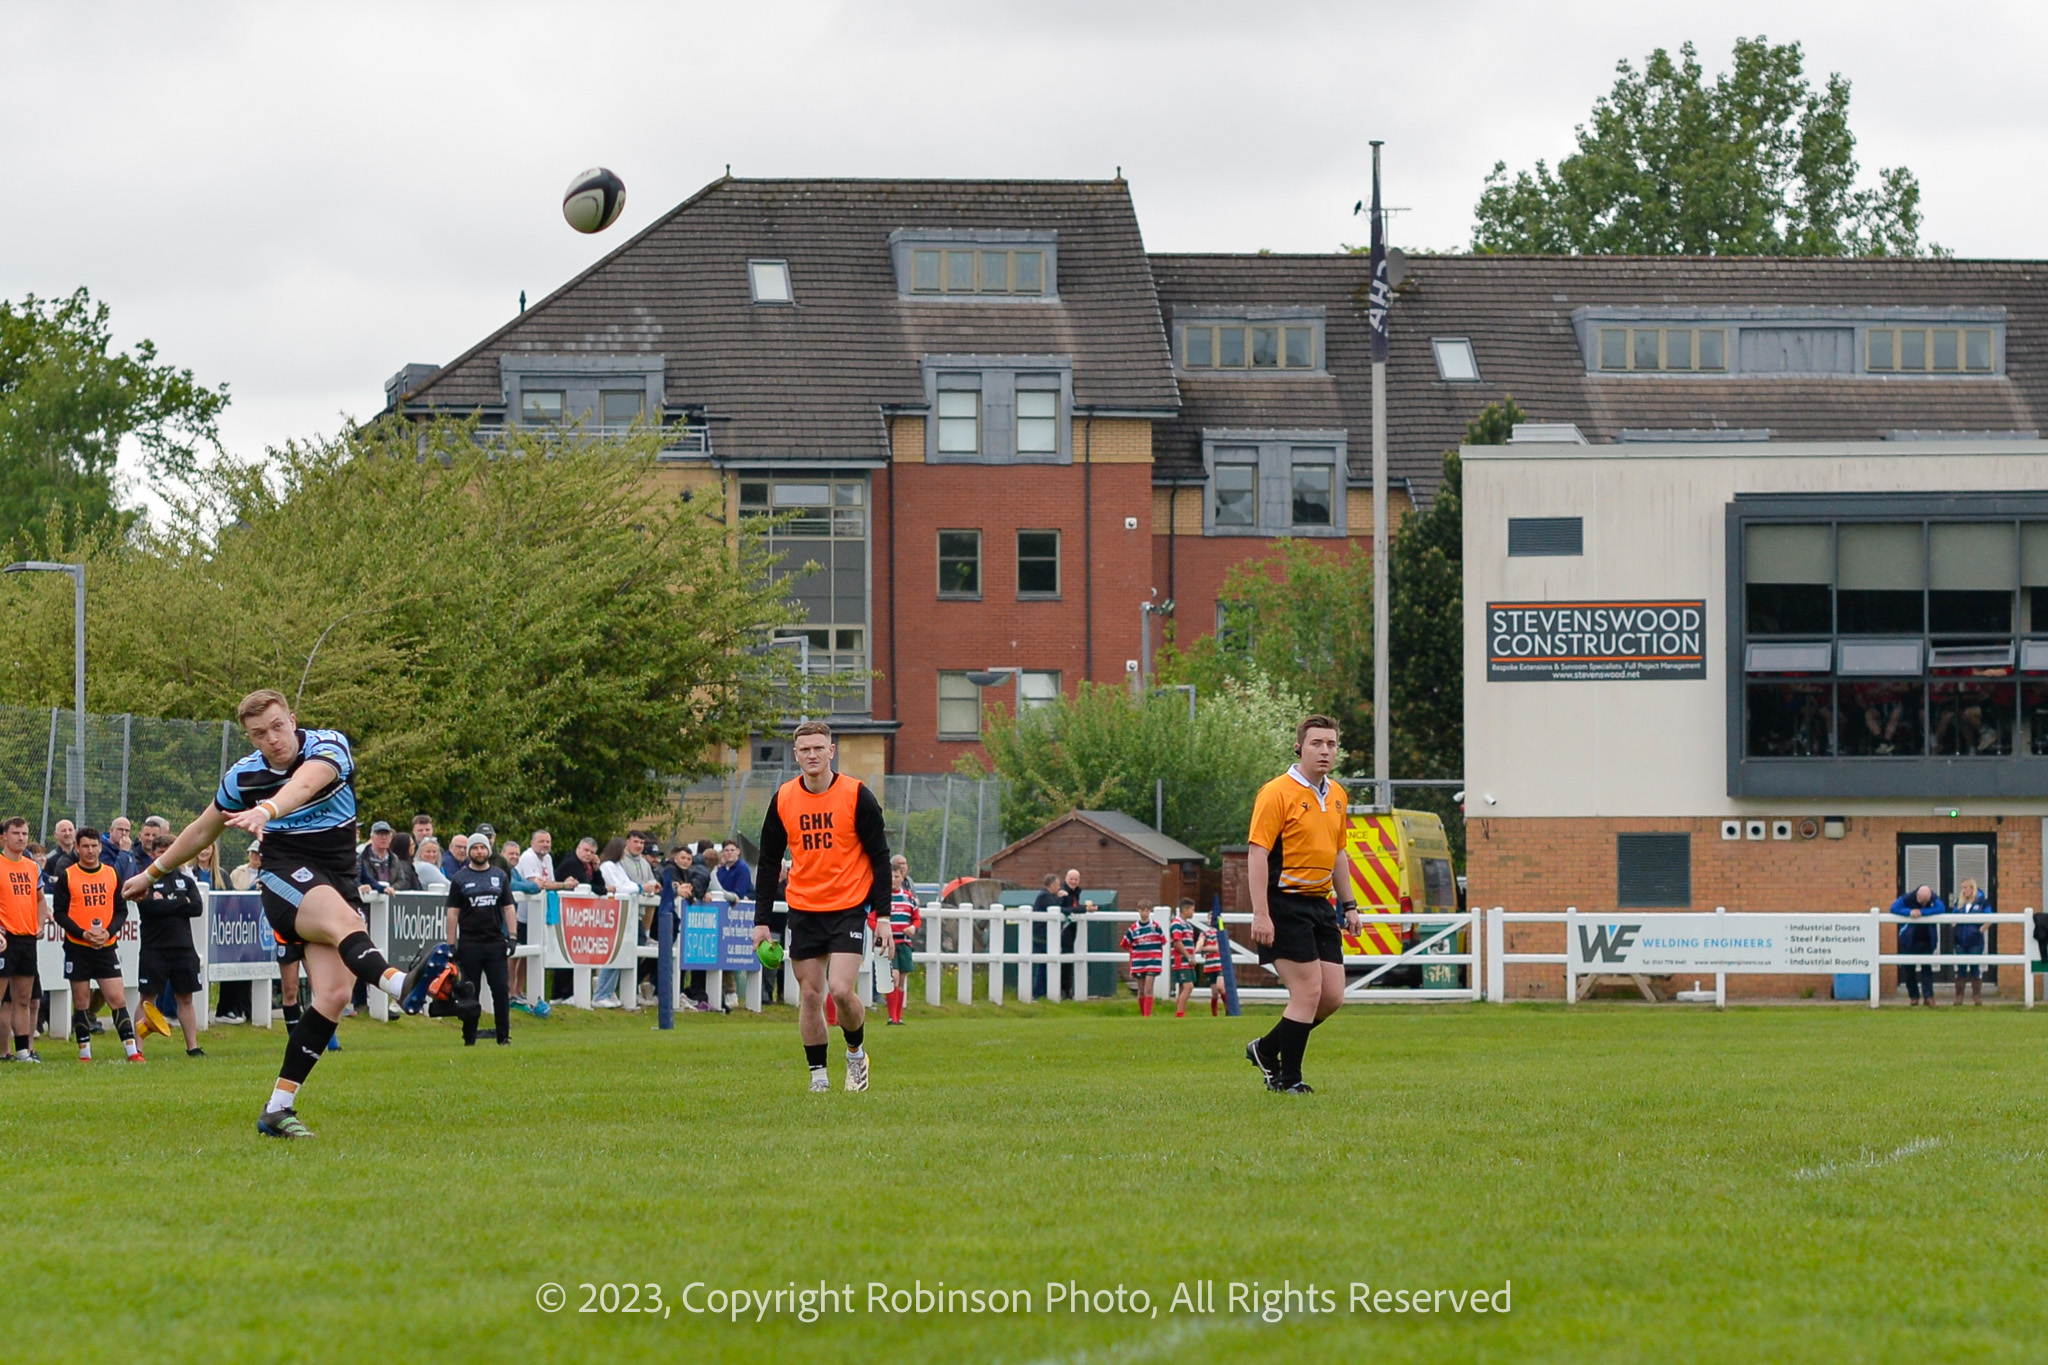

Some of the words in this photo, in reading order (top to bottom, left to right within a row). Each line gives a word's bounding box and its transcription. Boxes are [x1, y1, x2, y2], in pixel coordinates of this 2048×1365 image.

[1493, 608, 1700, 633] STEVENSWOOD
[1492, 632, 1700, 656] CONSTRUCTION
[1491, 663, 1518, 673] Bespoke
[1519, 662, 1553, 671] Extensions
[1553, 663, 1560, 671] &
[1560, 662, 1588, 671] Sunroom
[1624, 661, 1637, 670] Full
[1637, 661, 1660, 671] Project
[1660, 661, 1701, 671] Management
[1551, 669, 1641, 680] www.stevenswood.net
[799, 812, 834, 831] GHK
[802, 832, 833, 851] RFC
[9, 872, 32, 884] GHK
[13, 884, 32, 896] RFC
[82, 883, 107, 895] GHK
[83, 895, 107, 907] RFC
[468, 894, 499, 907] VSN
[687, 911, 717, 929] BREATHING
[210, 913, 257, 946] Aberdein
[1789, 924, 1833, 932] Industrial
[1834, 924, 1861, 932] Doors
[1642, 938, 1700, 948] WELDING
[1703, 938, 1773, 948] ENGINEERS
[1790, 935, 1814, 943] Steel
[1814, 935, 1866, 943] Fabrication
[571, 936, 610, 955] COACHES
[686, 933, 717, 958] SPACE
[1789, 947, 1804, 955] Lift
[1806, 947, 1832, 955] Gates
[1789, 958, 1833, 966] Industrial
[1834, 958, 1870, 967] Roofing
